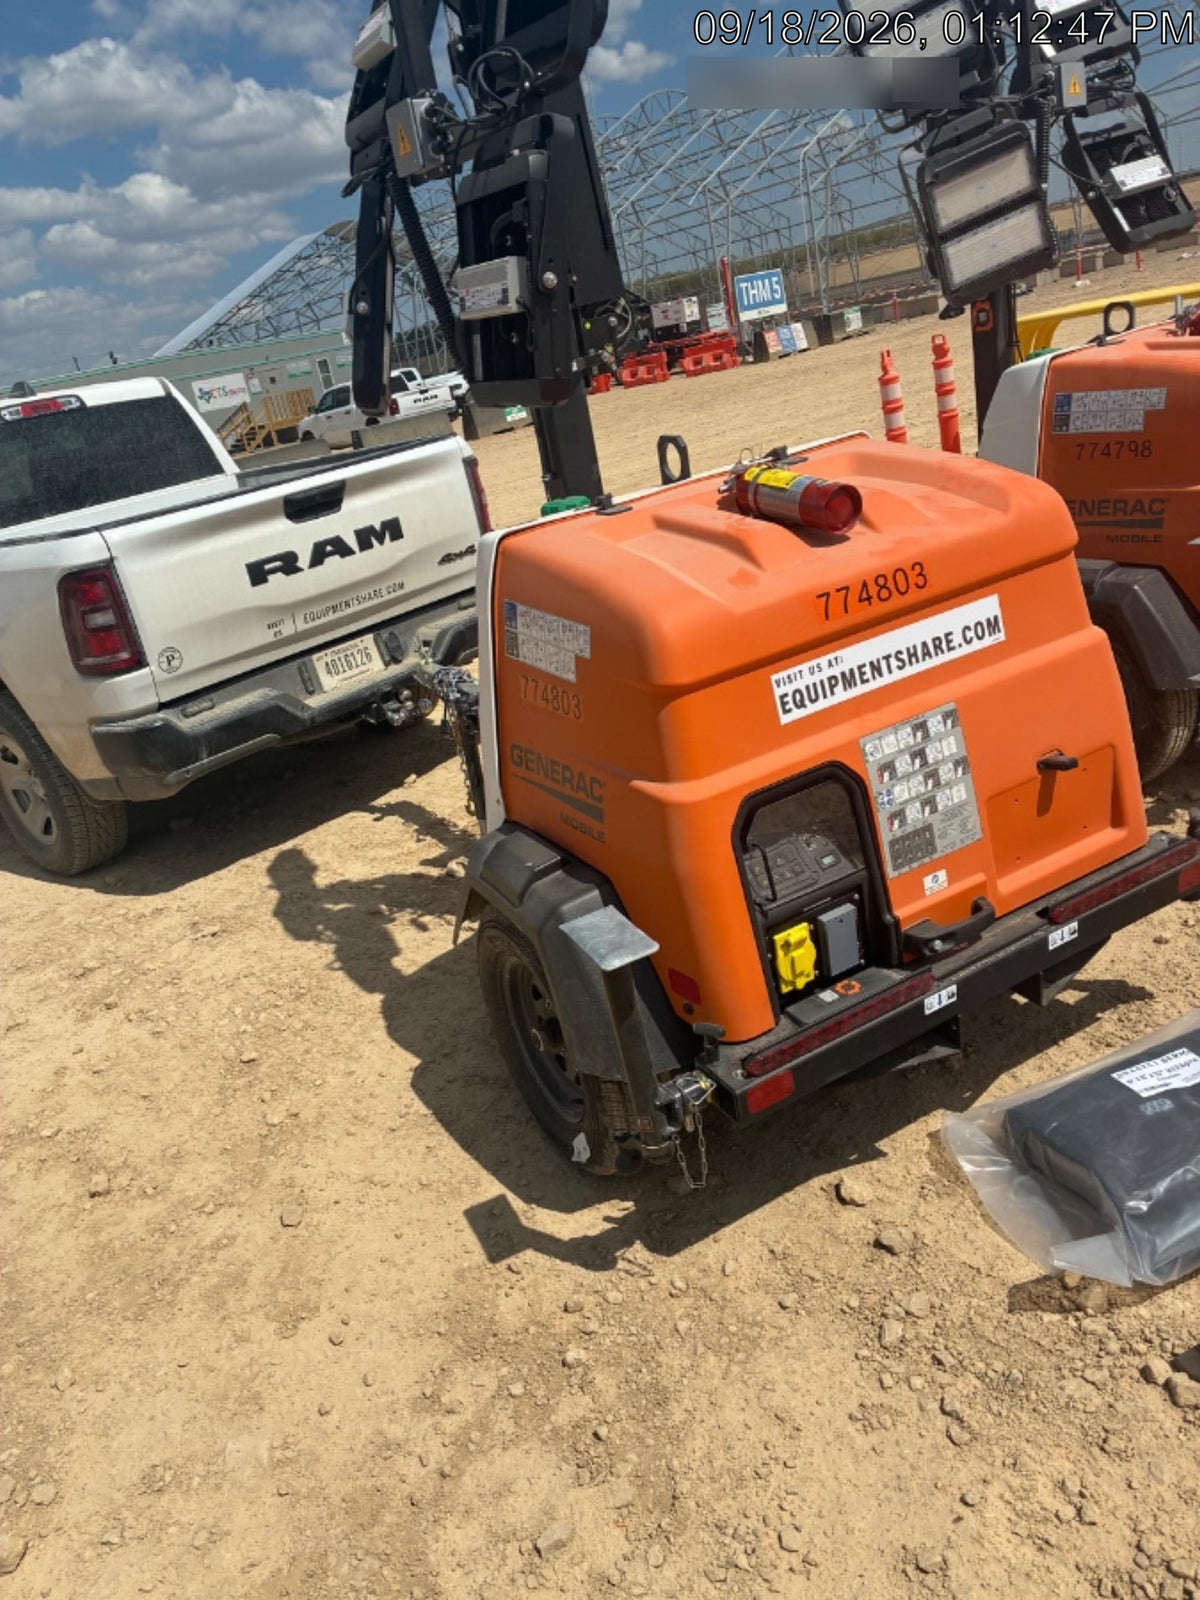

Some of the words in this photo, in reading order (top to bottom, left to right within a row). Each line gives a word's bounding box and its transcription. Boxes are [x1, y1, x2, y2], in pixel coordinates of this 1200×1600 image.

[740, 279, 772, 306] THM
[772, 277, 781, 299] 5
[1075, 440, 1153, 461] 774798
[1066, 498, 1165, 516] ENERAC
[245, 516, 404, 588] RAM
[1106, 533, 1163, 544] MOBILE
[303, 581, 405, 625] EQUIPMENTSHARE.COM
[816, 561, 928, 621] 774803
[324, 646, 373, 677] 4016126
[774, 670, 804, 688] VISIT
[808, 662, 823, 676] US
[778, 614, 1002, 715] EQUIPMENTSHARE.COM
[520, 675, 583, 720] 774803
[510, 743, 604, 804] GENERAC
[560, 811, 606, 844] MOBILE
